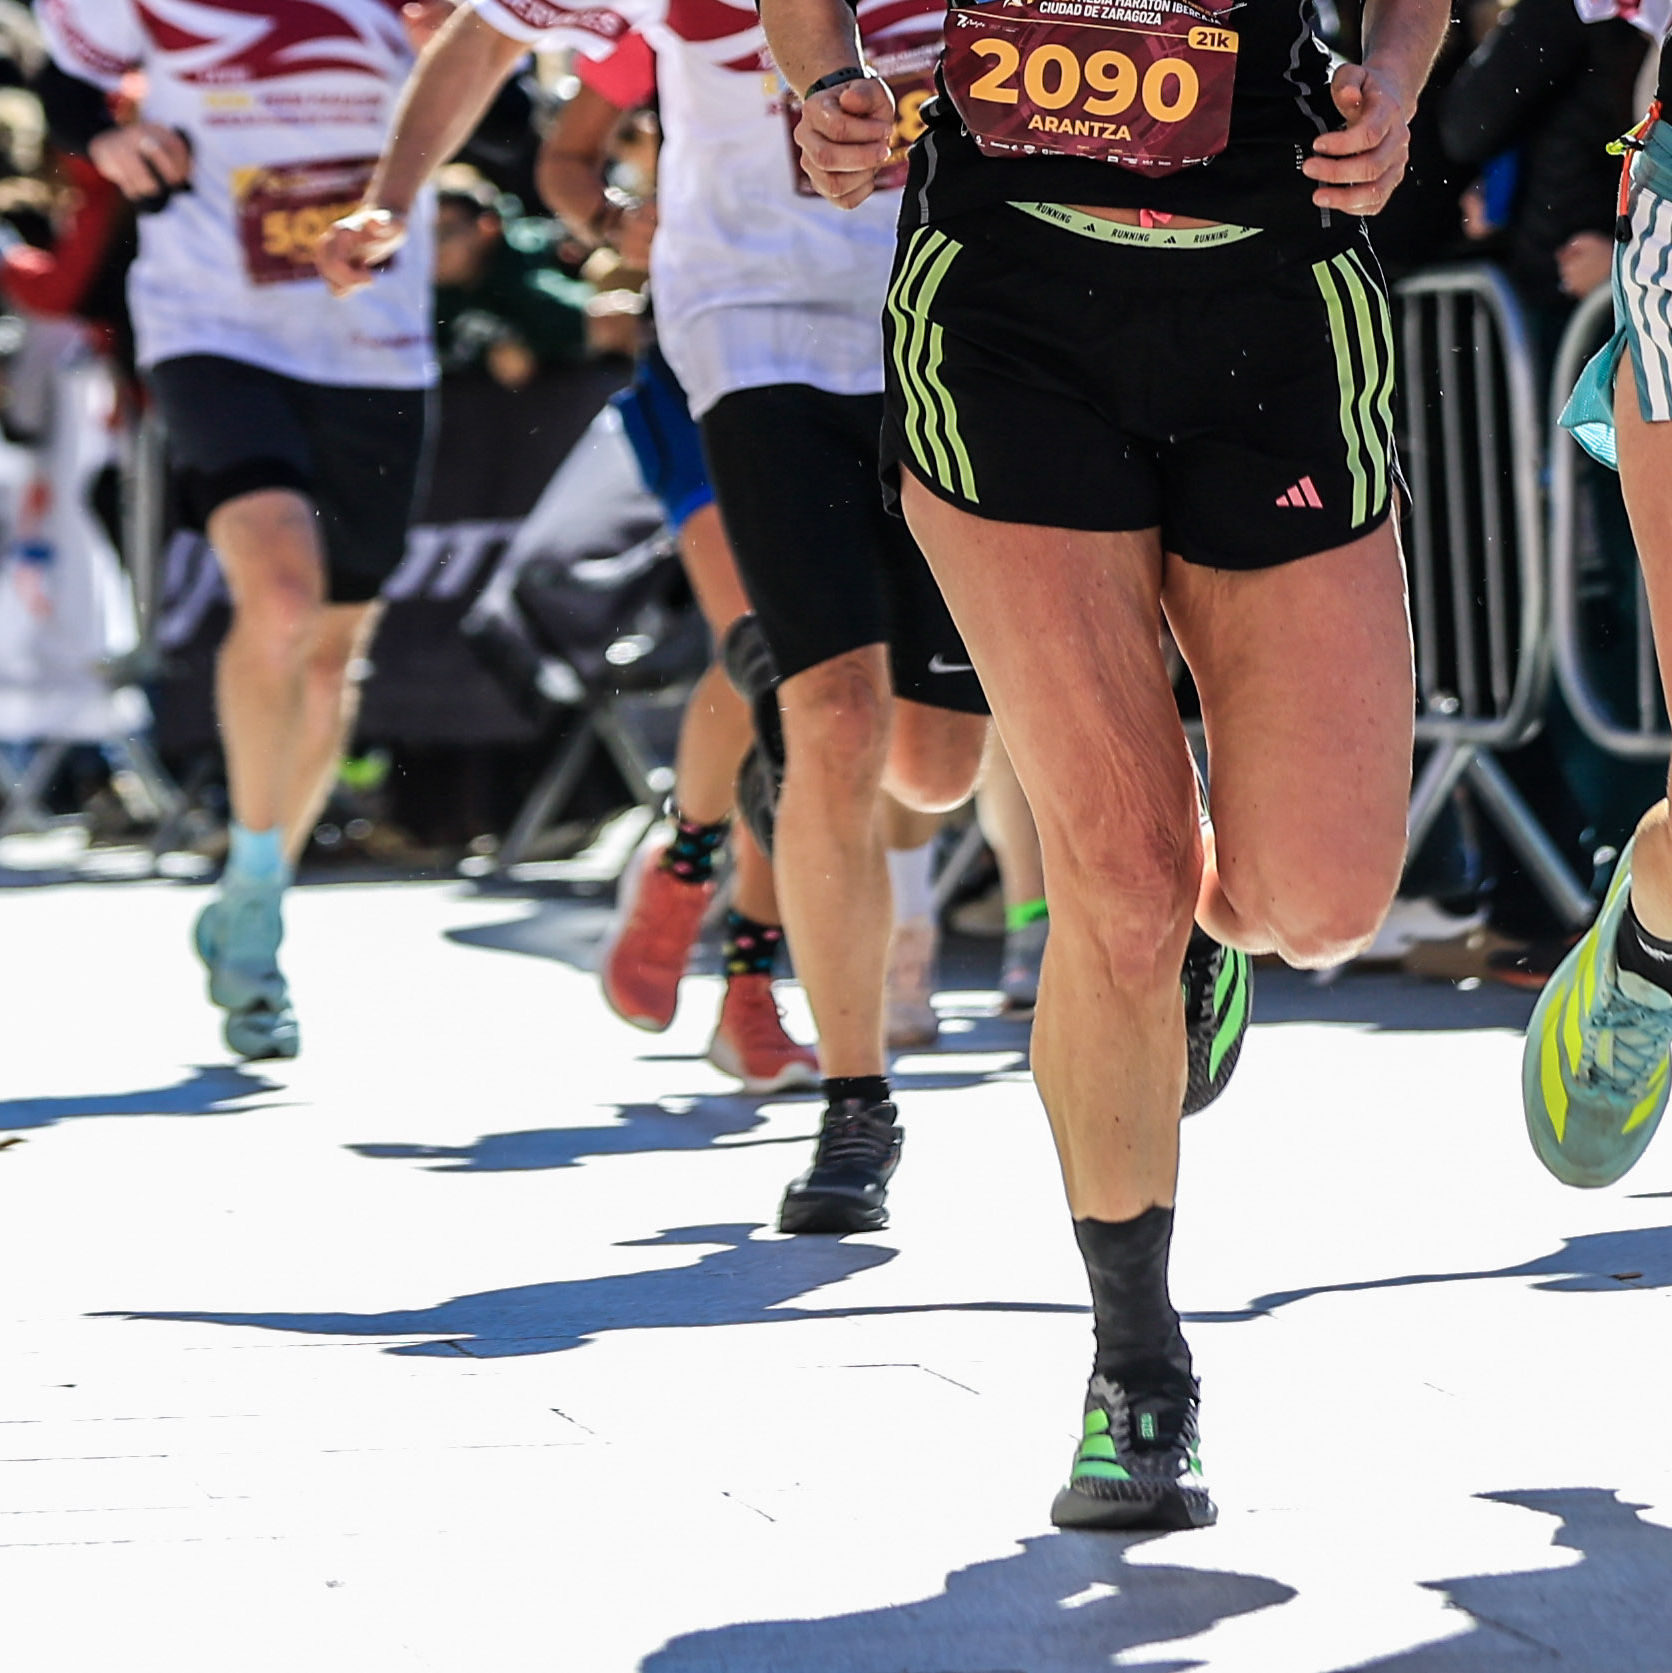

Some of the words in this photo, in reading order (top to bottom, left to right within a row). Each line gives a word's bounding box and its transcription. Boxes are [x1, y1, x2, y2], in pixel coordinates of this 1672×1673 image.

[1039, 1, 1082, 17] CIUDAD
[1084, 5, 1099, 18] DE
[1100, 6, 1162, 26] ZARAGOZA
[1196, 31, 1230, 48] 21k
[969, 38, 1200, 123] 2090
[1028, 115, 1132, 141] ARANTZA
[1035, 202, 1072, 224] RUNNING
[1111, 229, 1150, 243] RUNNING
[1193, 230, 1229, 244] RUNNING
